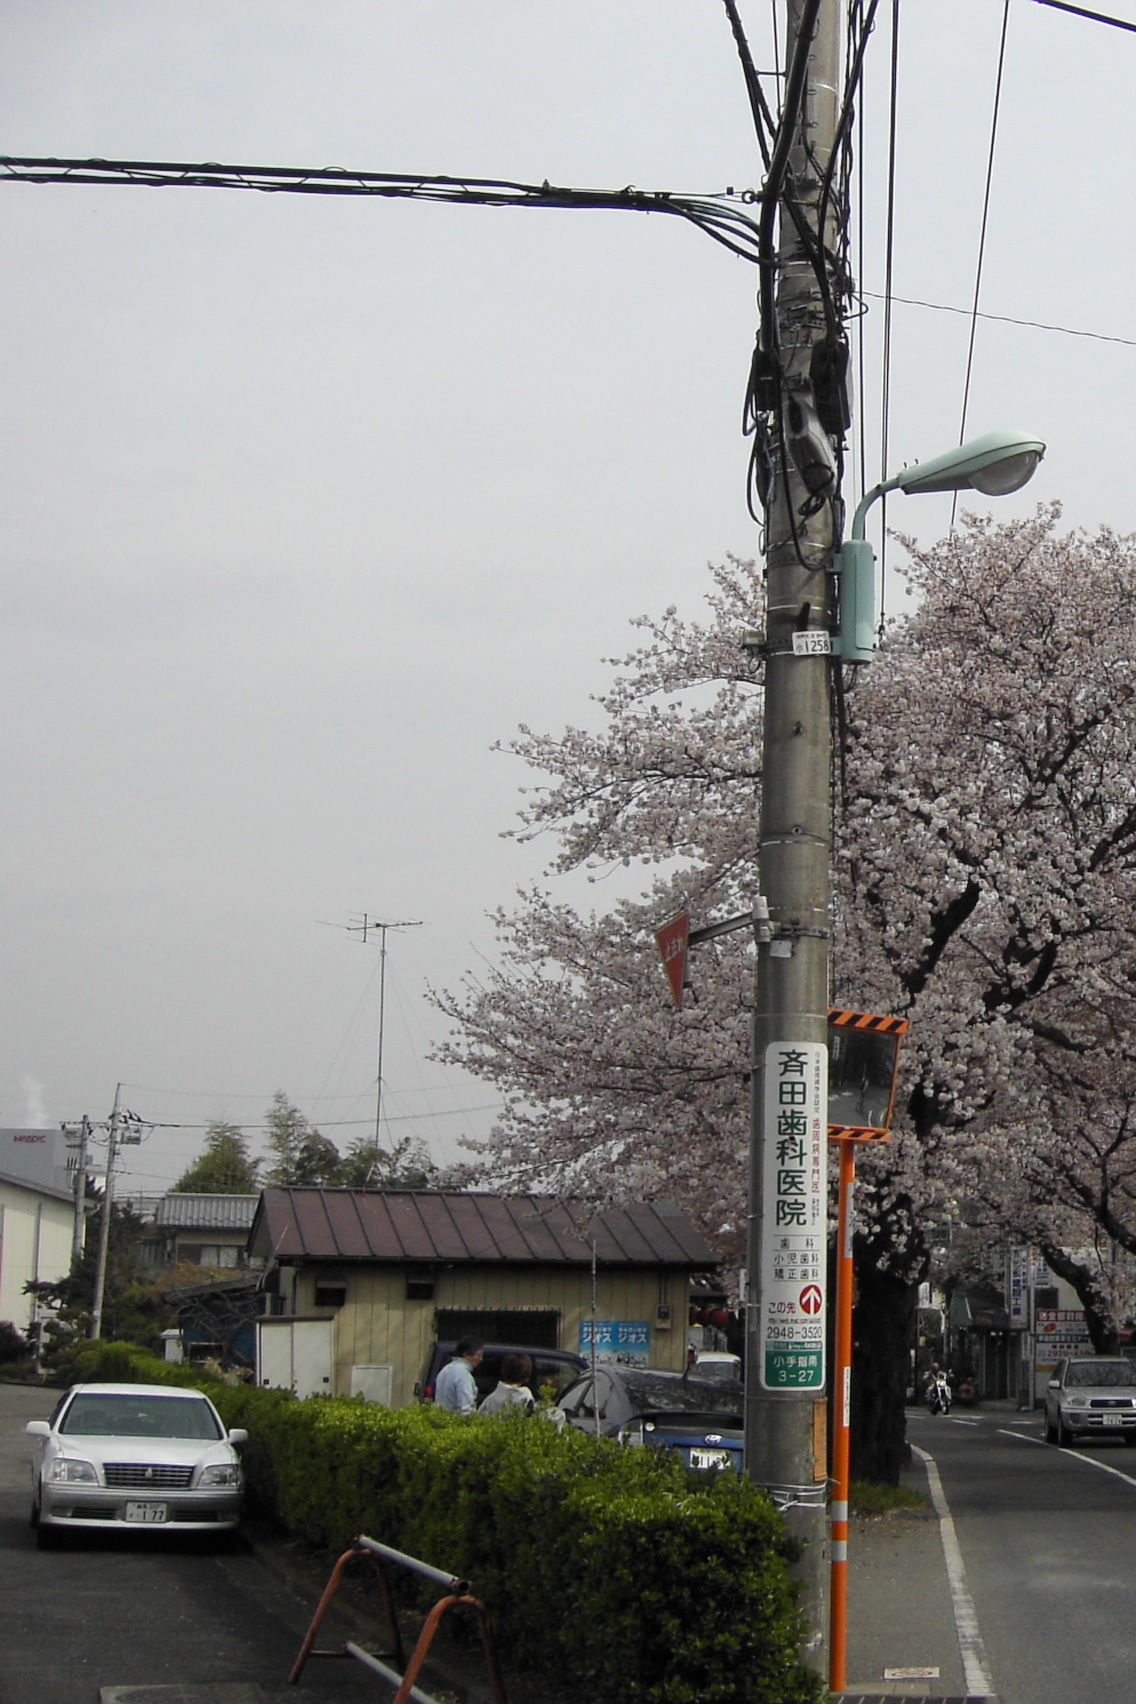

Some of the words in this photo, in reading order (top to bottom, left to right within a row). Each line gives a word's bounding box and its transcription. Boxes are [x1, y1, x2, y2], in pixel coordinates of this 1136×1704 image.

[776, 1049, 808, 1226] 斉田歯科医院
[774, 1252, 819, 1265] 小児歯科
[774, 1268, 819, 1280] 矯正歯科
[768, 1302, 796, 1315] この先
[582, 1333, 612, 1344] ジオス
[618, 1333, 647, 1344] ジオス
[767, 1327, 822, 1340] 2948-3520
[779, 1370, 815, 1382] 3-27
